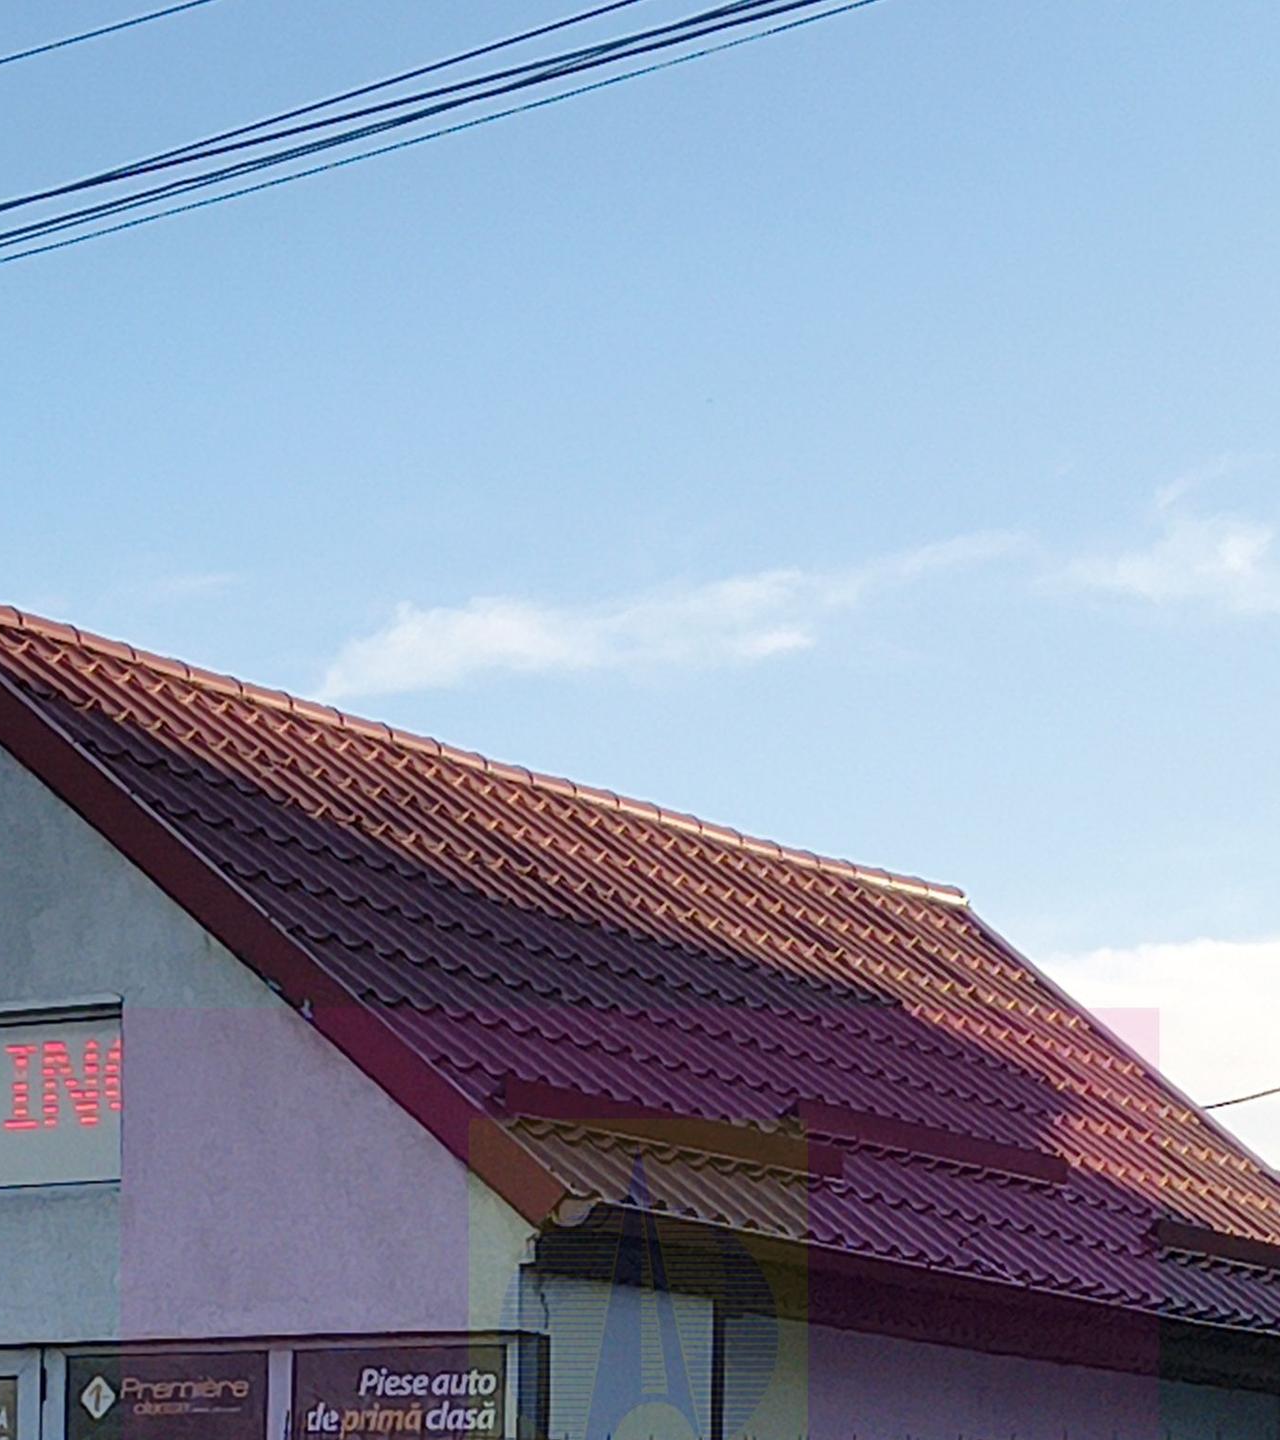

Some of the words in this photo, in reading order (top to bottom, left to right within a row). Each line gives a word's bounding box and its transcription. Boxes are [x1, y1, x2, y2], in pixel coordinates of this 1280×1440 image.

[358, 1367, 428, 1396] Piese
[431, 1369, 496, 1396] auto
[307, 1401, 339, 1432] de
[425, 1400, 495, 1431] clasă
